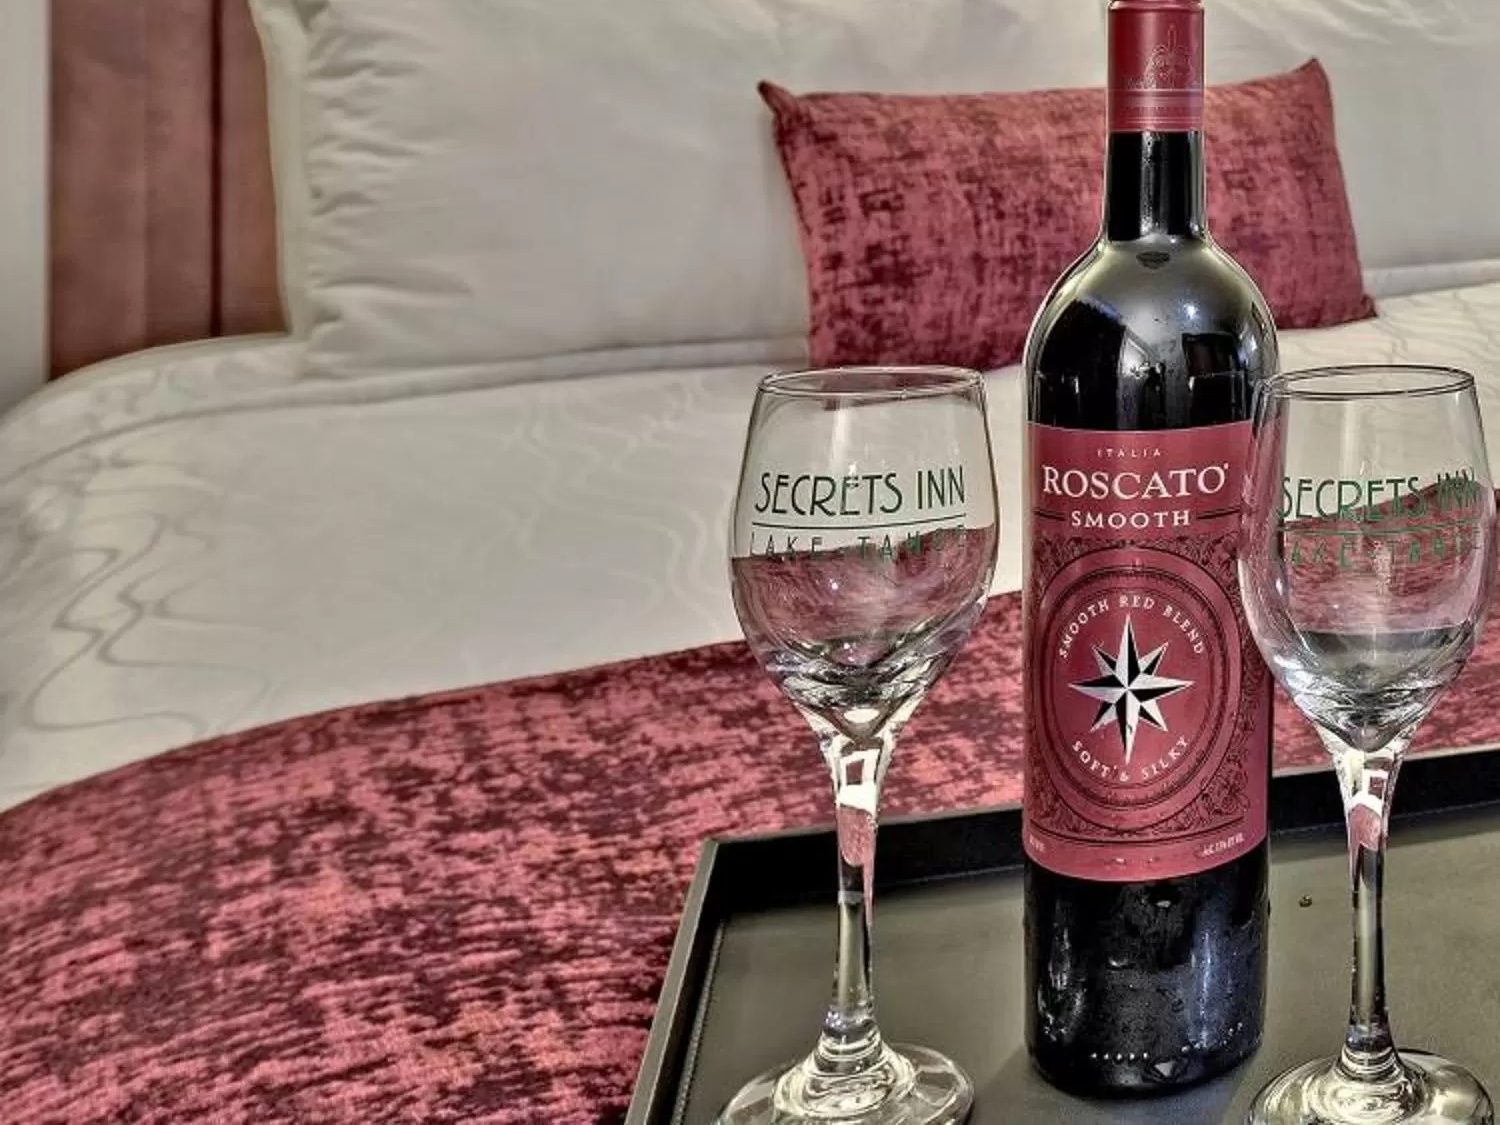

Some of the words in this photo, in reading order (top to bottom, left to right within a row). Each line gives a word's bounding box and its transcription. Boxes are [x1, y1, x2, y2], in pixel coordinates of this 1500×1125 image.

[1096, 447, 1162, 459] ITALIA
[753, 471, 904, 517] SECRETS
[917, 465, 966, 510] INN
[1041, 462, 1227, 501] ROSCATO
[1276, 475, 1429, 522] SECRETS
[1071, 509, 1191, 529] SMOOTH
[750, 530, 825, 562] LAKE
[1279, 537, 1356, 570] AKE
[1058, 598, 1110, 660] SMOOTH
[1118, 593, 1156, 611] RED
[1162, 604, 1205, 655] BLEND
[1140, 734, 1189, 781] SILKY
